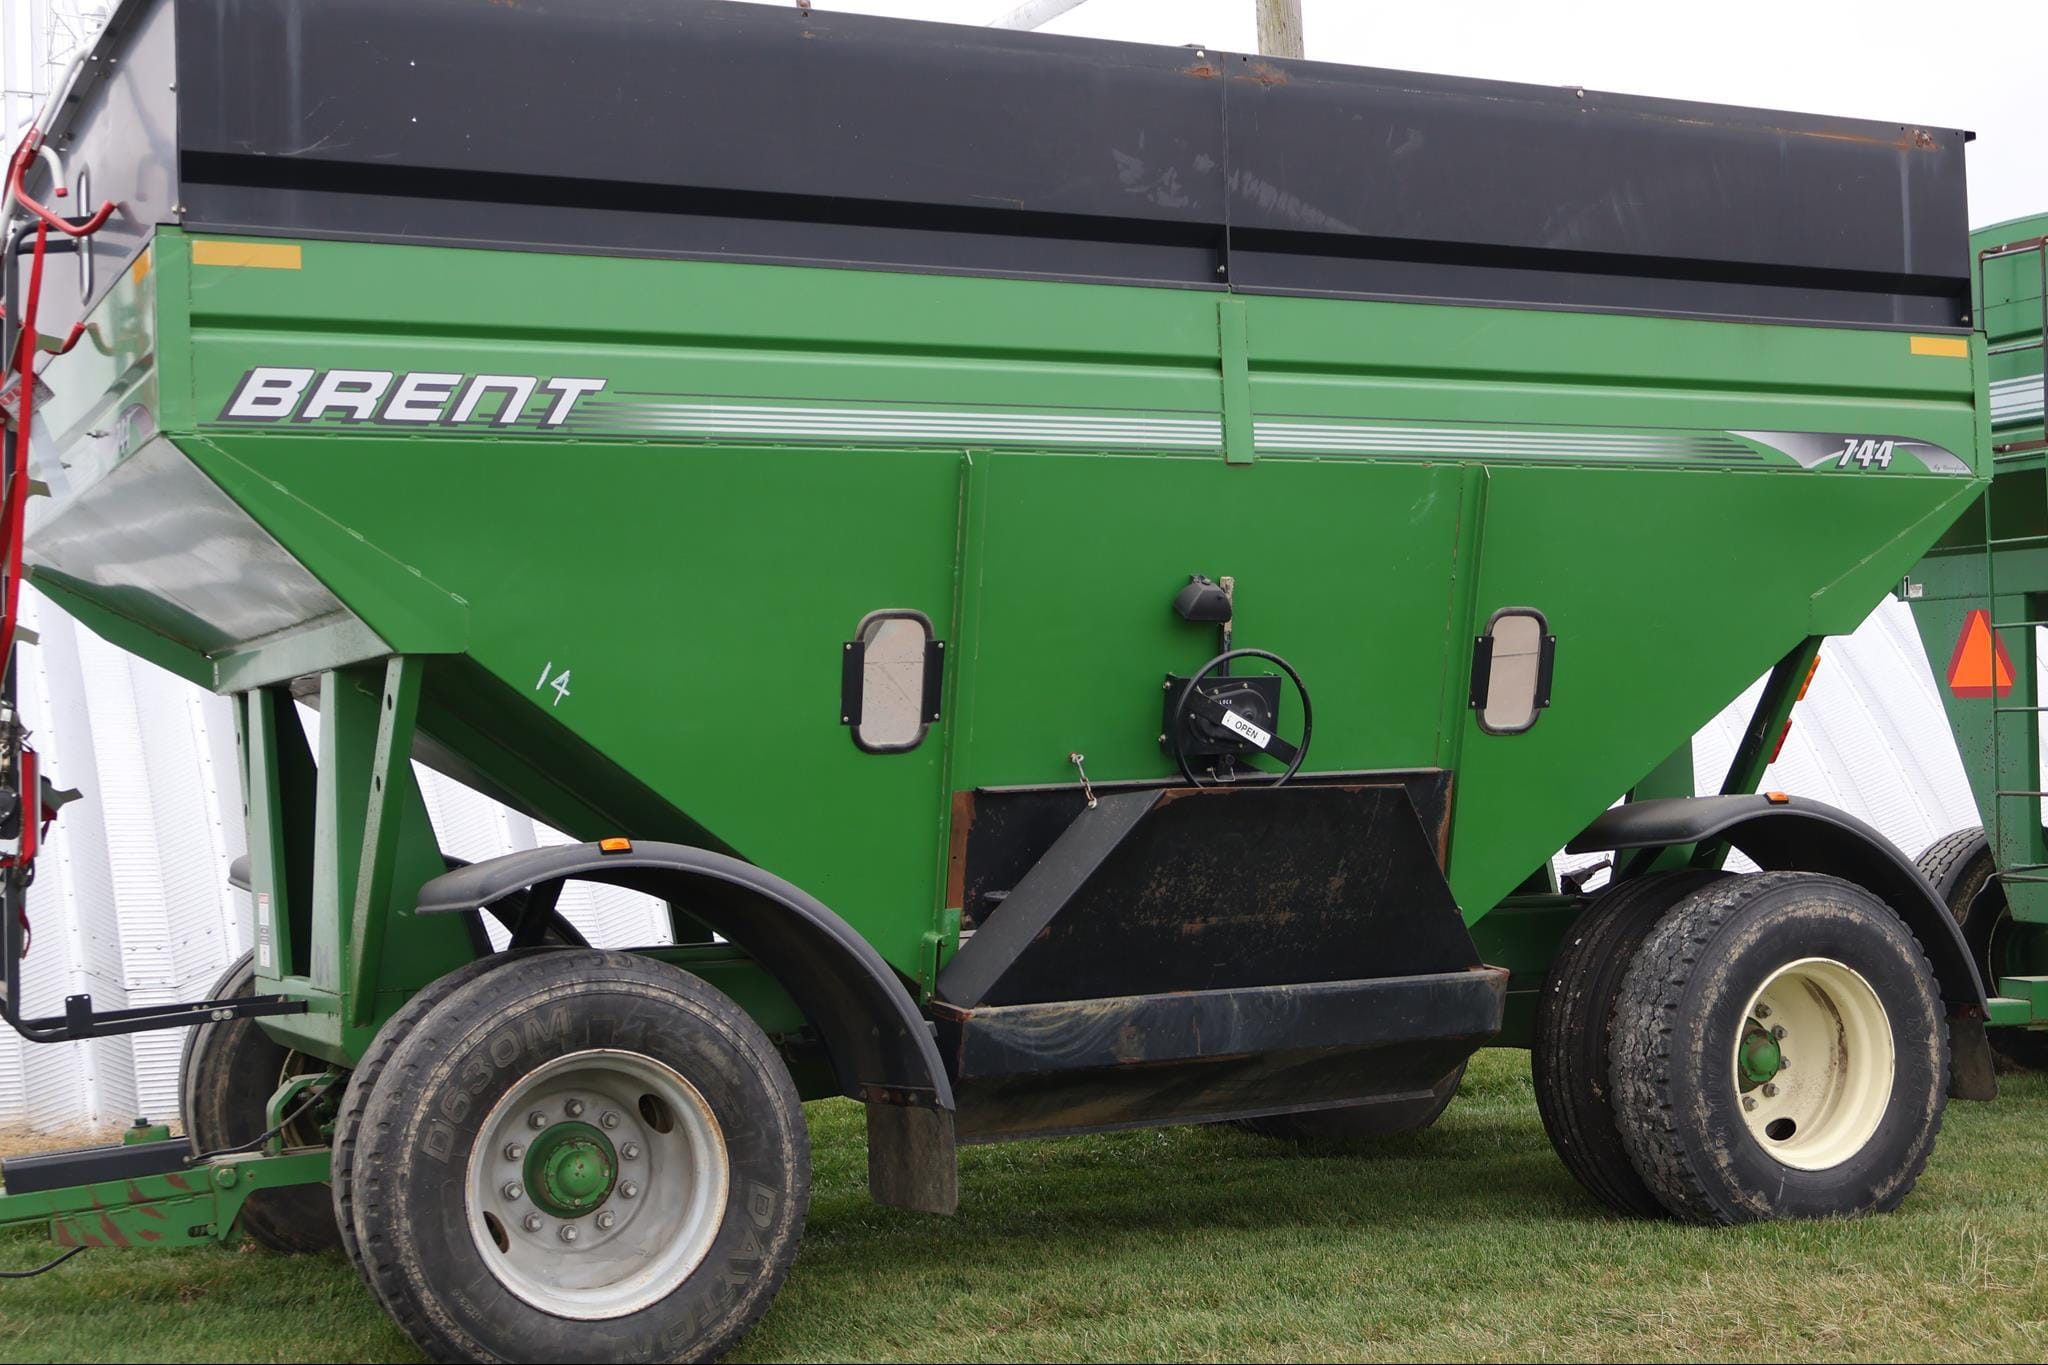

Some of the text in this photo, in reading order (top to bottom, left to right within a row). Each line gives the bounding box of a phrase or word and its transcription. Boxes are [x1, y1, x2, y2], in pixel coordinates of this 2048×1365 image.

[218, 366, 608, 430] BRENT
[1835, 438, 1895, 470] 744
[535, 661, 571, 706] 14
[1235, 720, 1258, 739] OPEN
